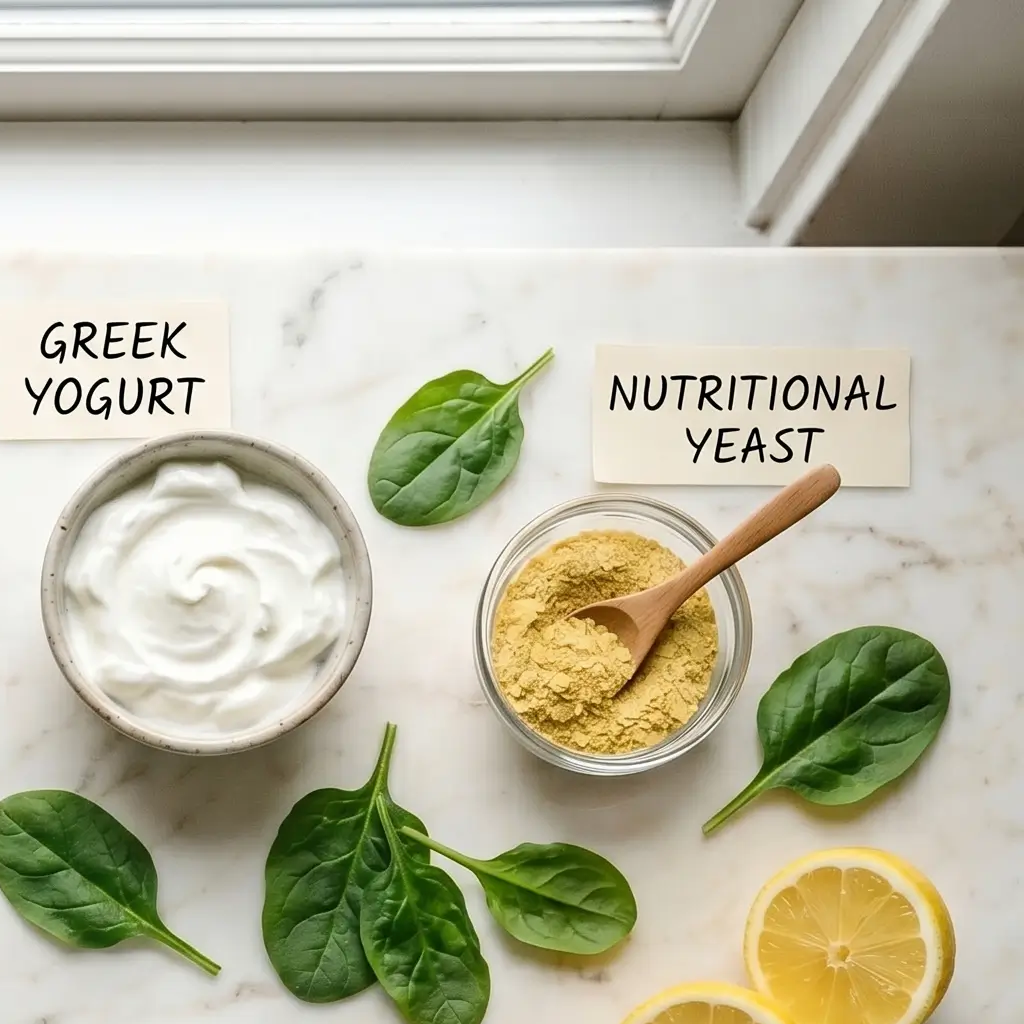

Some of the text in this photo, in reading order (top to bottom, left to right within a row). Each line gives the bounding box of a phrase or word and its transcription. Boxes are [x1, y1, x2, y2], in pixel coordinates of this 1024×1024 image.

[40, 321, 187, 365] GREEK
[24, 377, 206, 421] YOGURT
[609, 374, 897, 411] NUTRITIONAL
[685, 426, 825, 464] YEAST
